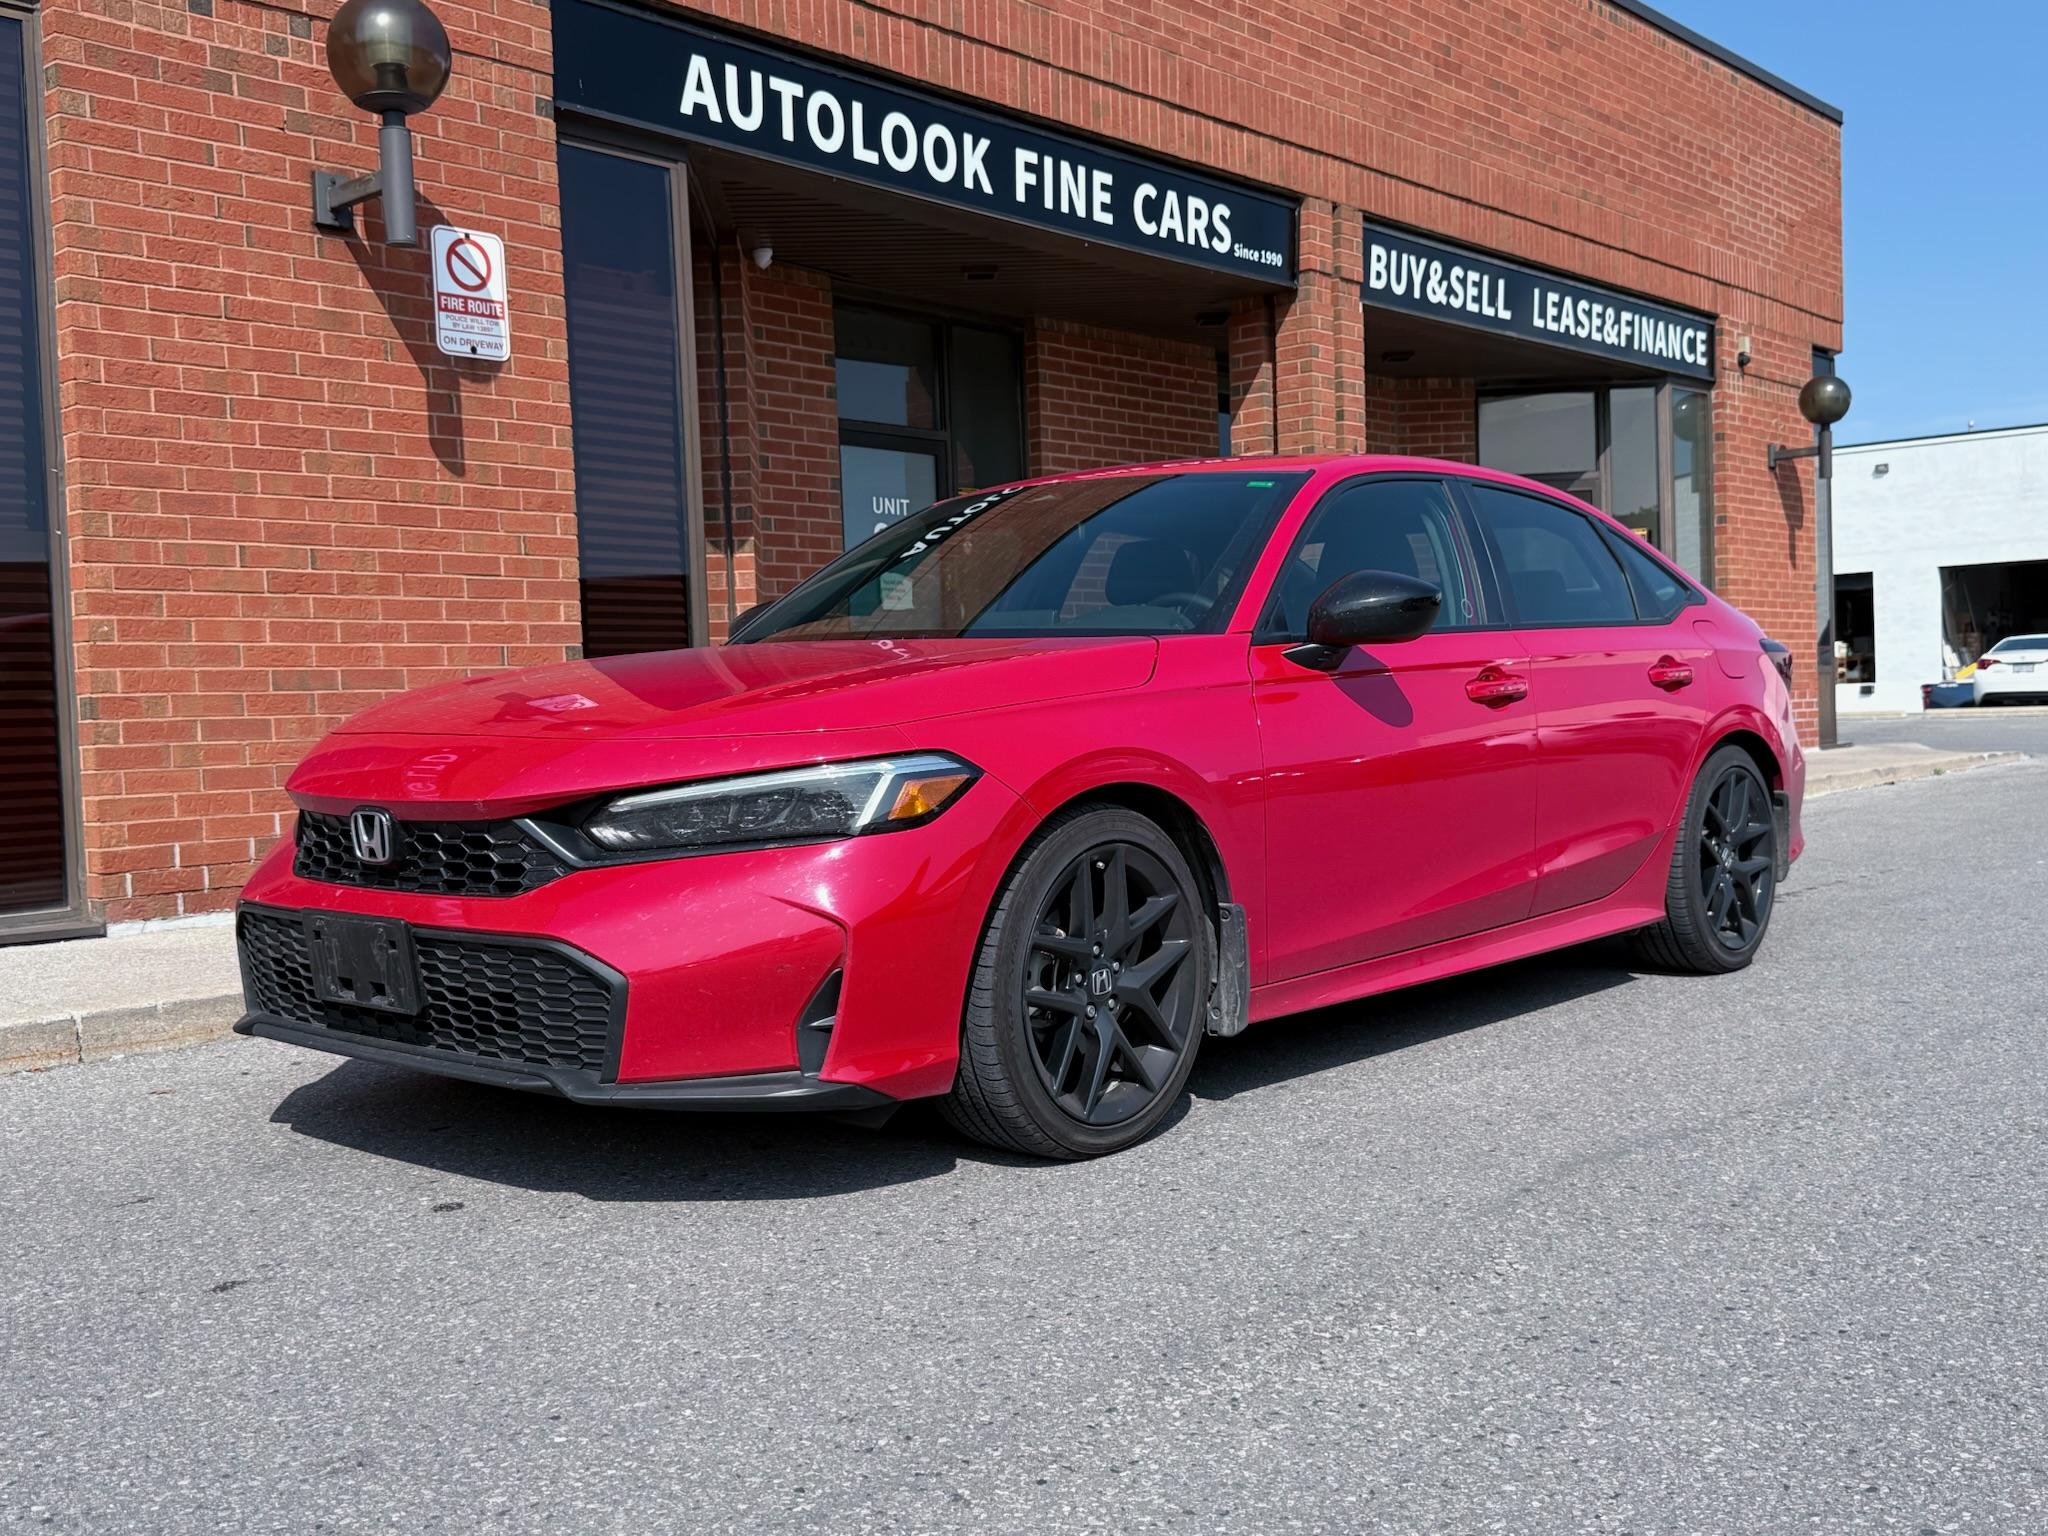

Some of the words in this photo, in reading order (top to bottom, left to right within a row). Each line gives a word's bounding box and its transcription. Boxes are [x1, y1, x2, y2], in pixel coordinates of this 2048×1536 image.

[680, 53, 994, 195] AUTOLOOK
[1016, 147, 1114, 226] FINE
[1133, 183, 1232, 255] CARS
[1234, 243, 1259, 262] Since
[1260, 250, 1283, 267] 1990
[441, 296, 465, 311] FIRE
[467, 299, 503, 316] ROUTE
[1369, 244, 1512, 320] BUY&SELL
[1532, 287, 1708, 366] LEASE&FINANCE
[446, 314, 468, 322] POLICE
[470, 317, 484, 325] WILL
[444, 336, 457, 345] ON
[460, 338, 504, 351] DRIVEWAY
[873, 496, 910, 516] UNIT
